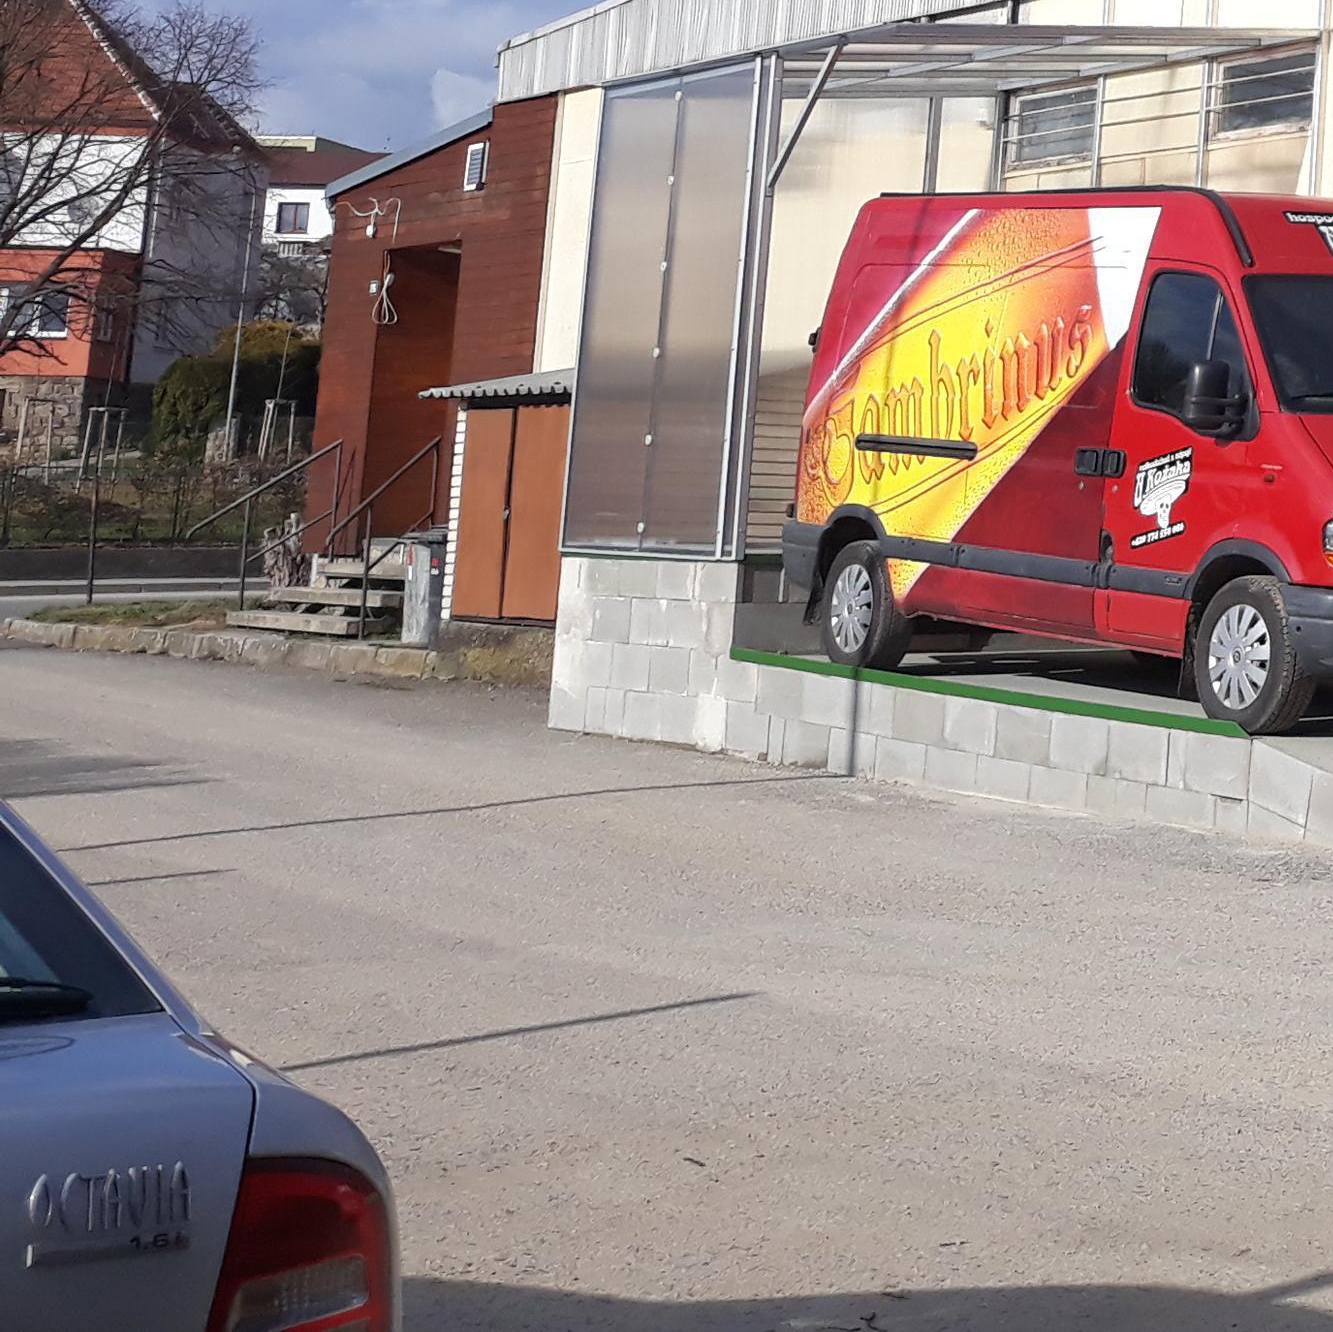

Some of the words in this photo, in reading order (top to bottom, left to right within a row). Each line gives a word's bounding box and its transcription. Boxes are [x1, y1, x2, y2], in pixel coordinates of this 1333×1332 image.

[802, 305, 1094, 508] Gambrinus
[1146, 460, 1190, 493] Kožaka
[27, 1160, 192, 1233] OCTAVIA
